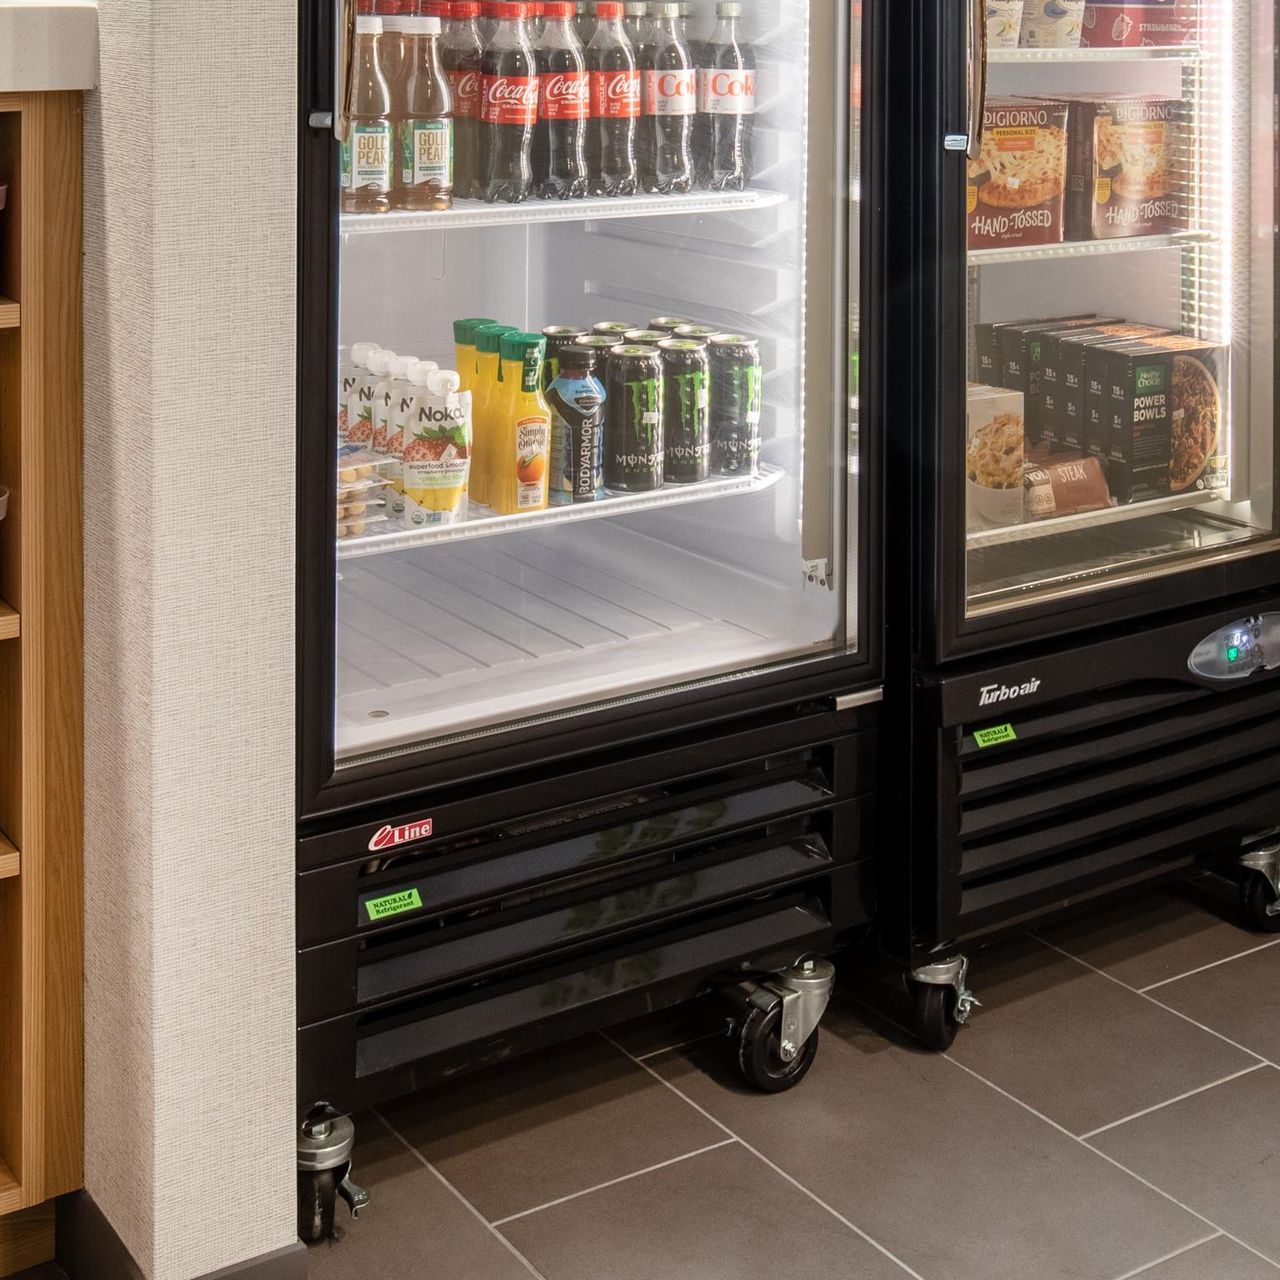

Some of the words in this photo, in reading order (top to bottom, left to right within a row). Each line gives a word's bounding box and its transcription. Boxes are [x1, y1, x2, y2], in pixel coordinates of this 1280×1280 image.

[1137, 378, 1160, 388] Choice
[1134, 394, 1166, 409] POWER
[1133, 406, 1166, 422] BOWLS
[519, 425, 546, 440] Simply
[578, 418, 593, 494] BODYARMOR
[409, 461, 444, 471] superfood
[1057, 461, 1087, 483] STEAK
[393, 821, 431, 843] Line
[373, 894, 408, 909] NATURAL
[375, 899, 414, 915] Refrigerant
